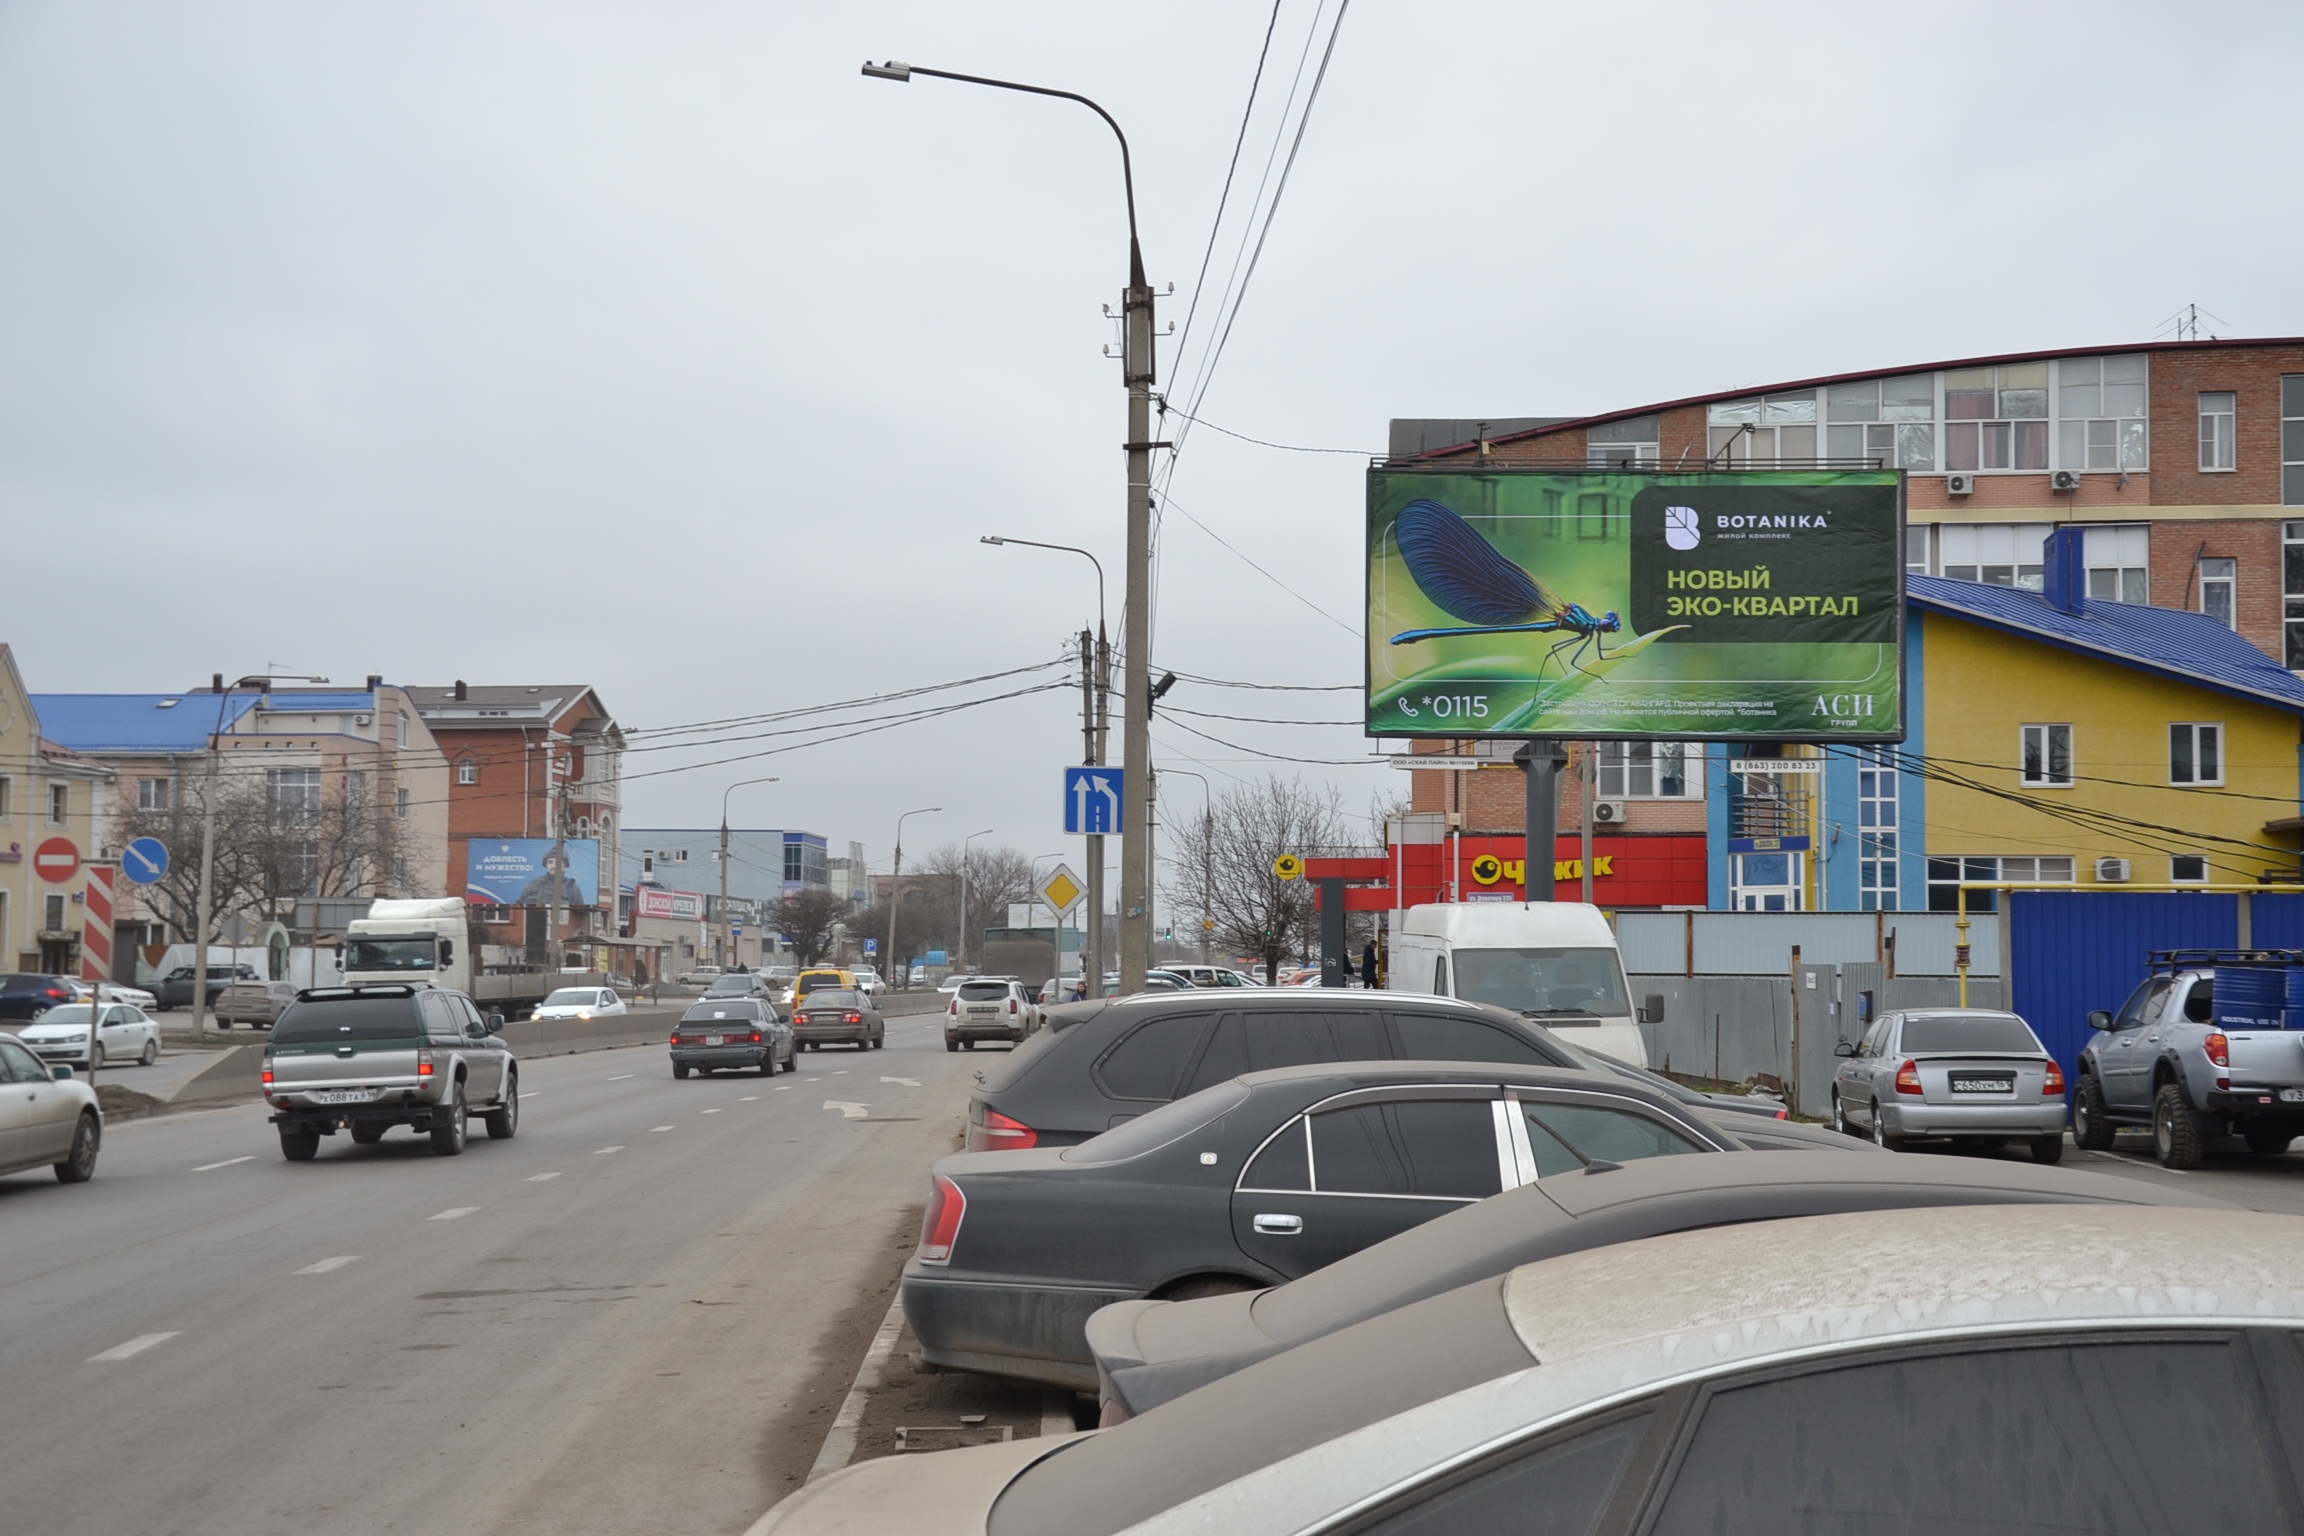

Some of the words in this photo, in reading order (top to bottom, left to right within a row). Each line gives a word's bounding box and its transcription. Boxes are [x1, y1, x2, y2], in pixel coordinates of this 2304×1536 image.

[1716, 515, 1828, 528] BOTANIKA
[1667, 565, 1771, 590] НОВЫЙ
[1666, 597, 1859, 616] ЭКО-КВАРТАЛ
[1674, 701, 1716, 709] Проектная
[1716, 701, 1763, 709] декларация
[1810, 694, 1874, 717] АСИ
[1657, 708, 1700, 717] публичной
[1744, 761, 1769, 771] (863)
